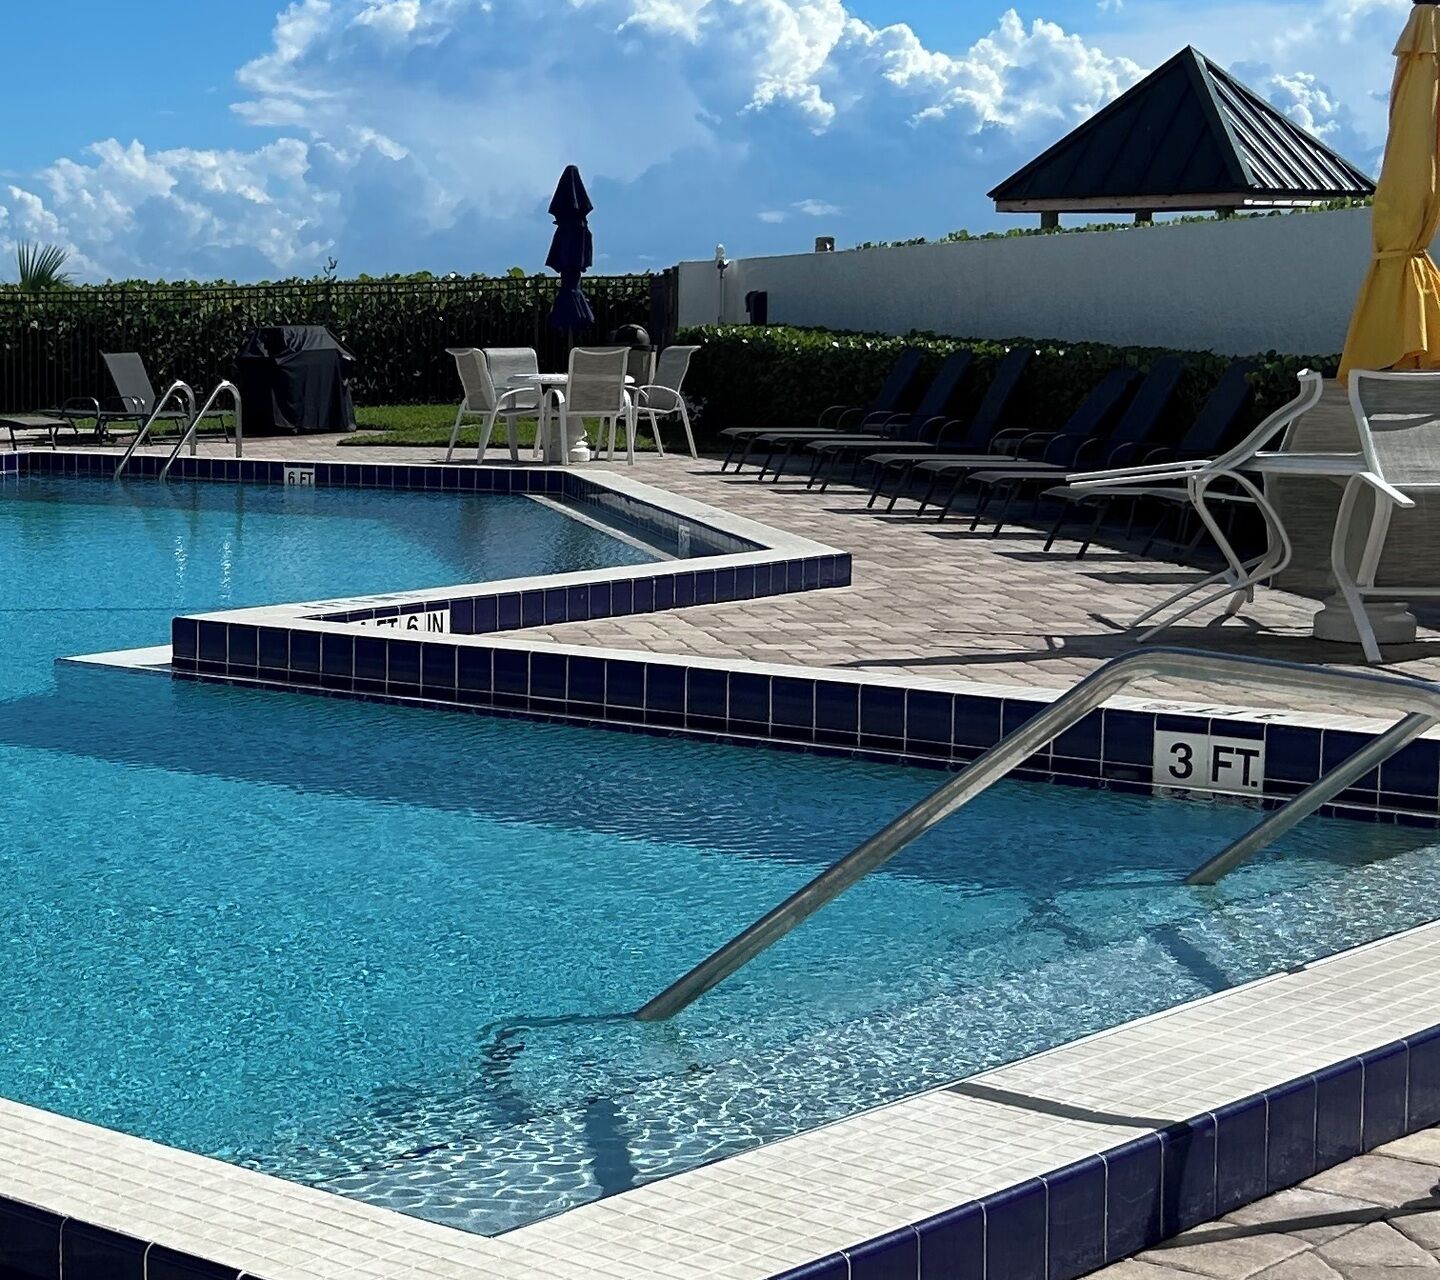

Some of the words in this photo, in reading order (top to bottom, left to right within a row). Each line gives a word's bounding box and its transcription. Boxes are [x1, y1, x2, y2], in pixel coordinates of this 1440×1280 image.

[288, 471, 295, 485] 6
[300, 472, 313, 485] FT
[406, 615, 419, 631] 6
[427, 612, 444, 634] IN
[1169, 742, 1193, 779] 3
[1211, 744, 1259, 788] FT.
